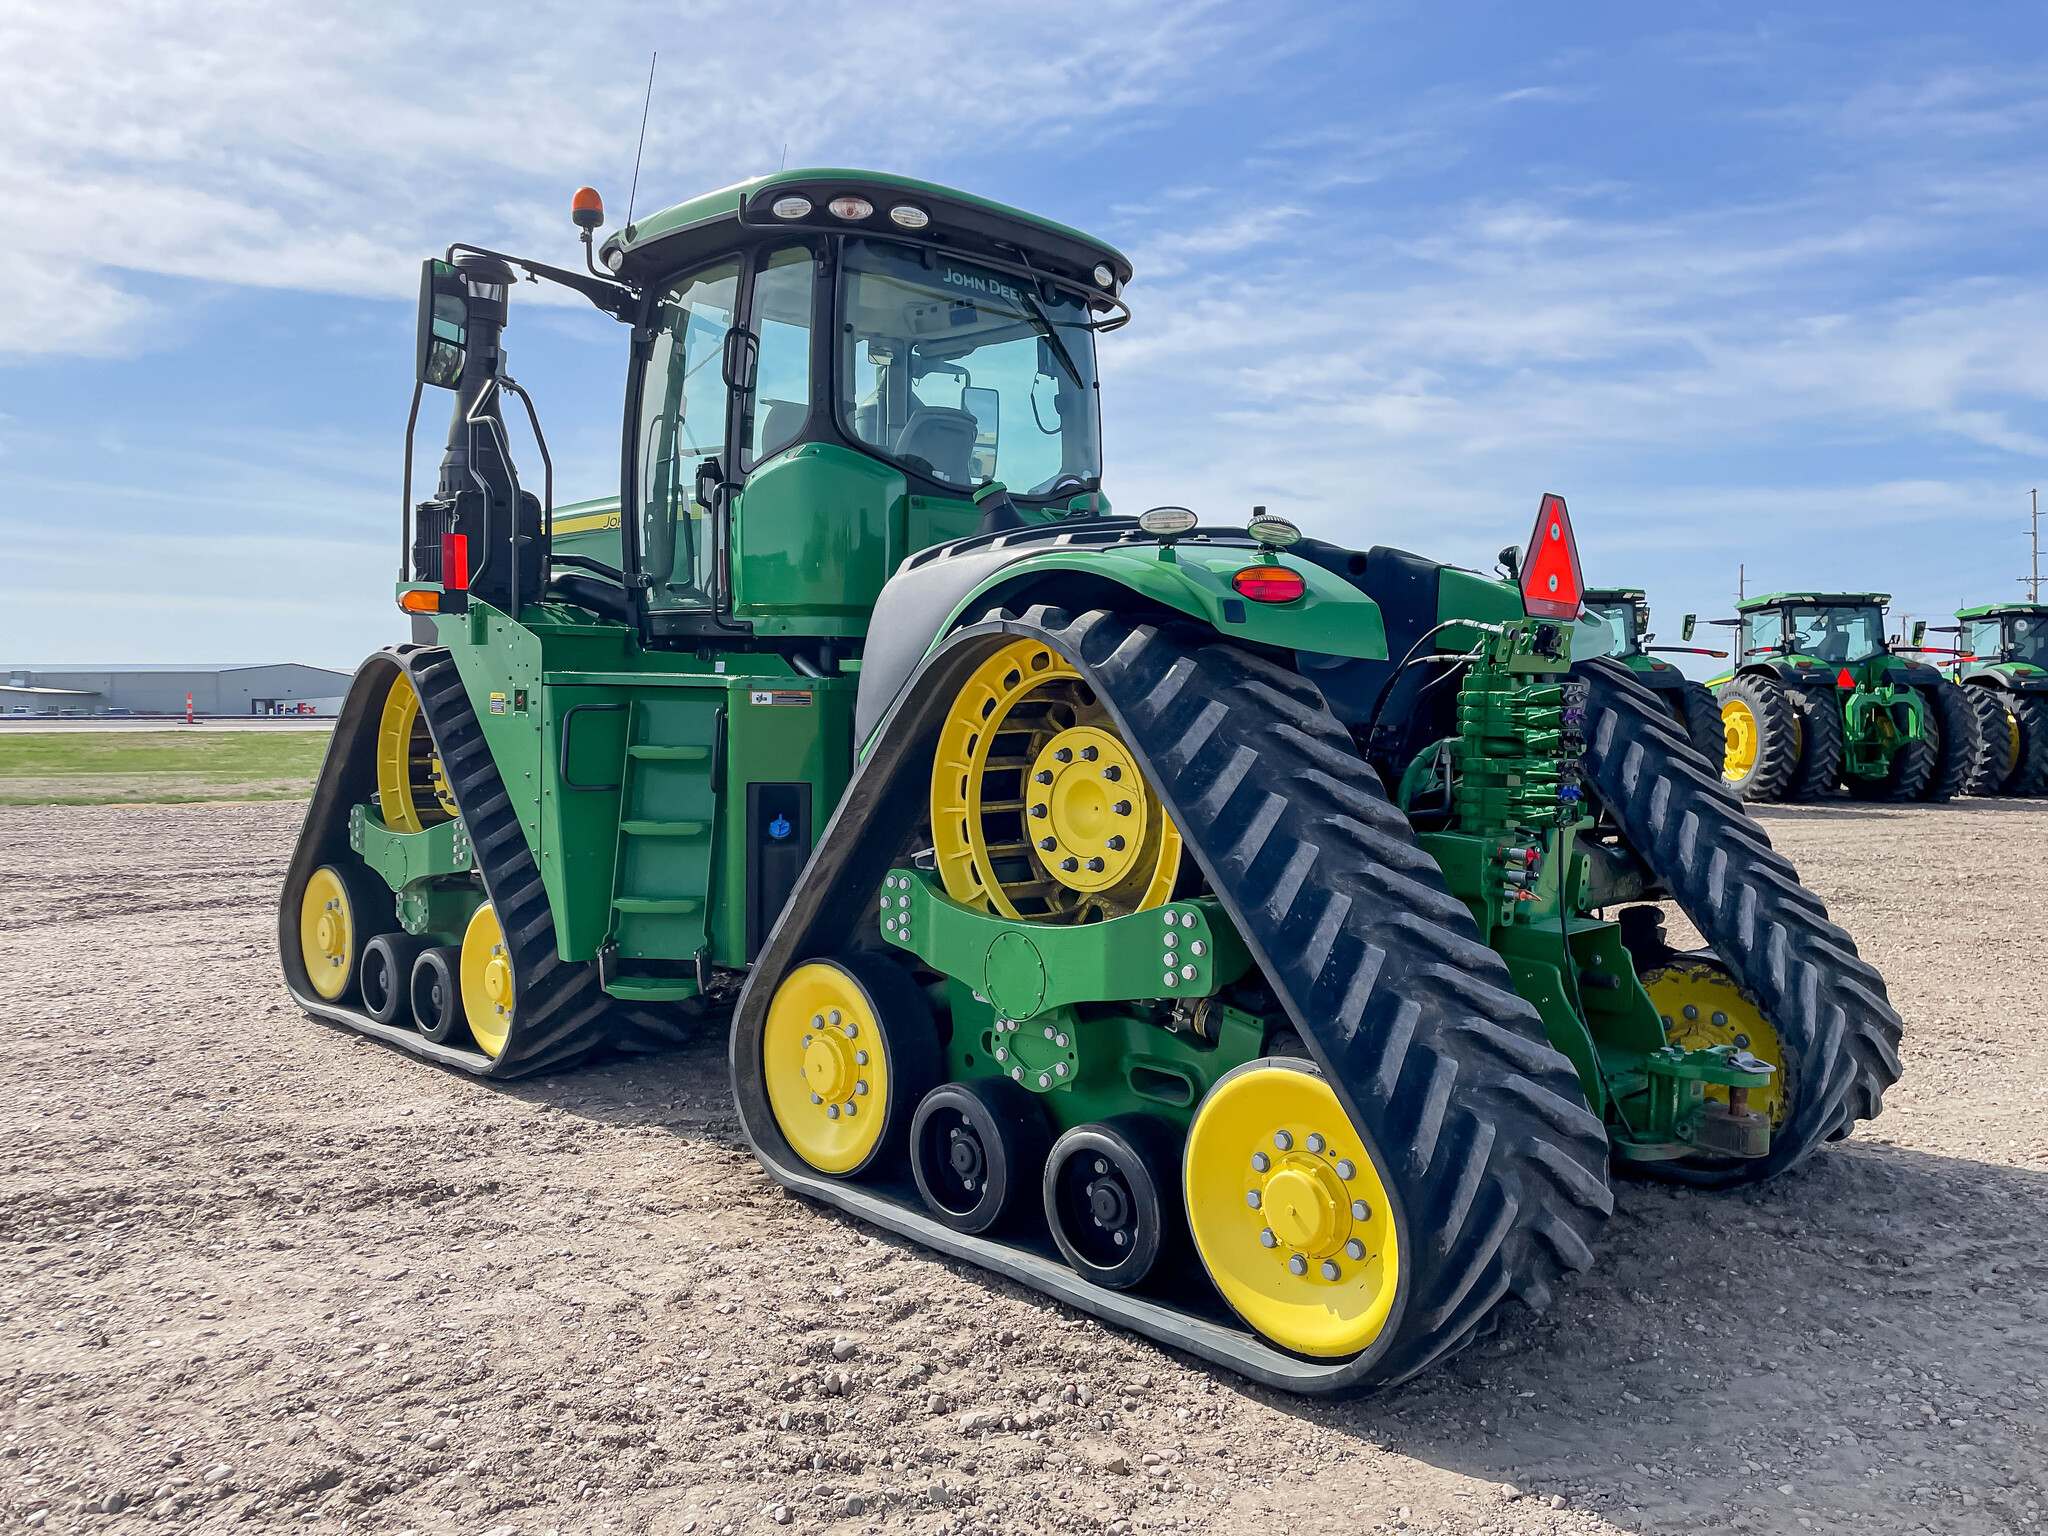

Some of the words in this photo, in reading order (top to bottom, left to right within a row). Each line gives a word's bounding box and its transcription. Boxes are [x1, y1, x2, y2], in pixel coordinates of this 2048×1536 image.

[943, 268, 986, 292] JOHN
[989, 278, 1037, 301] DEE
[277, 702, 317, 715] FedEx
